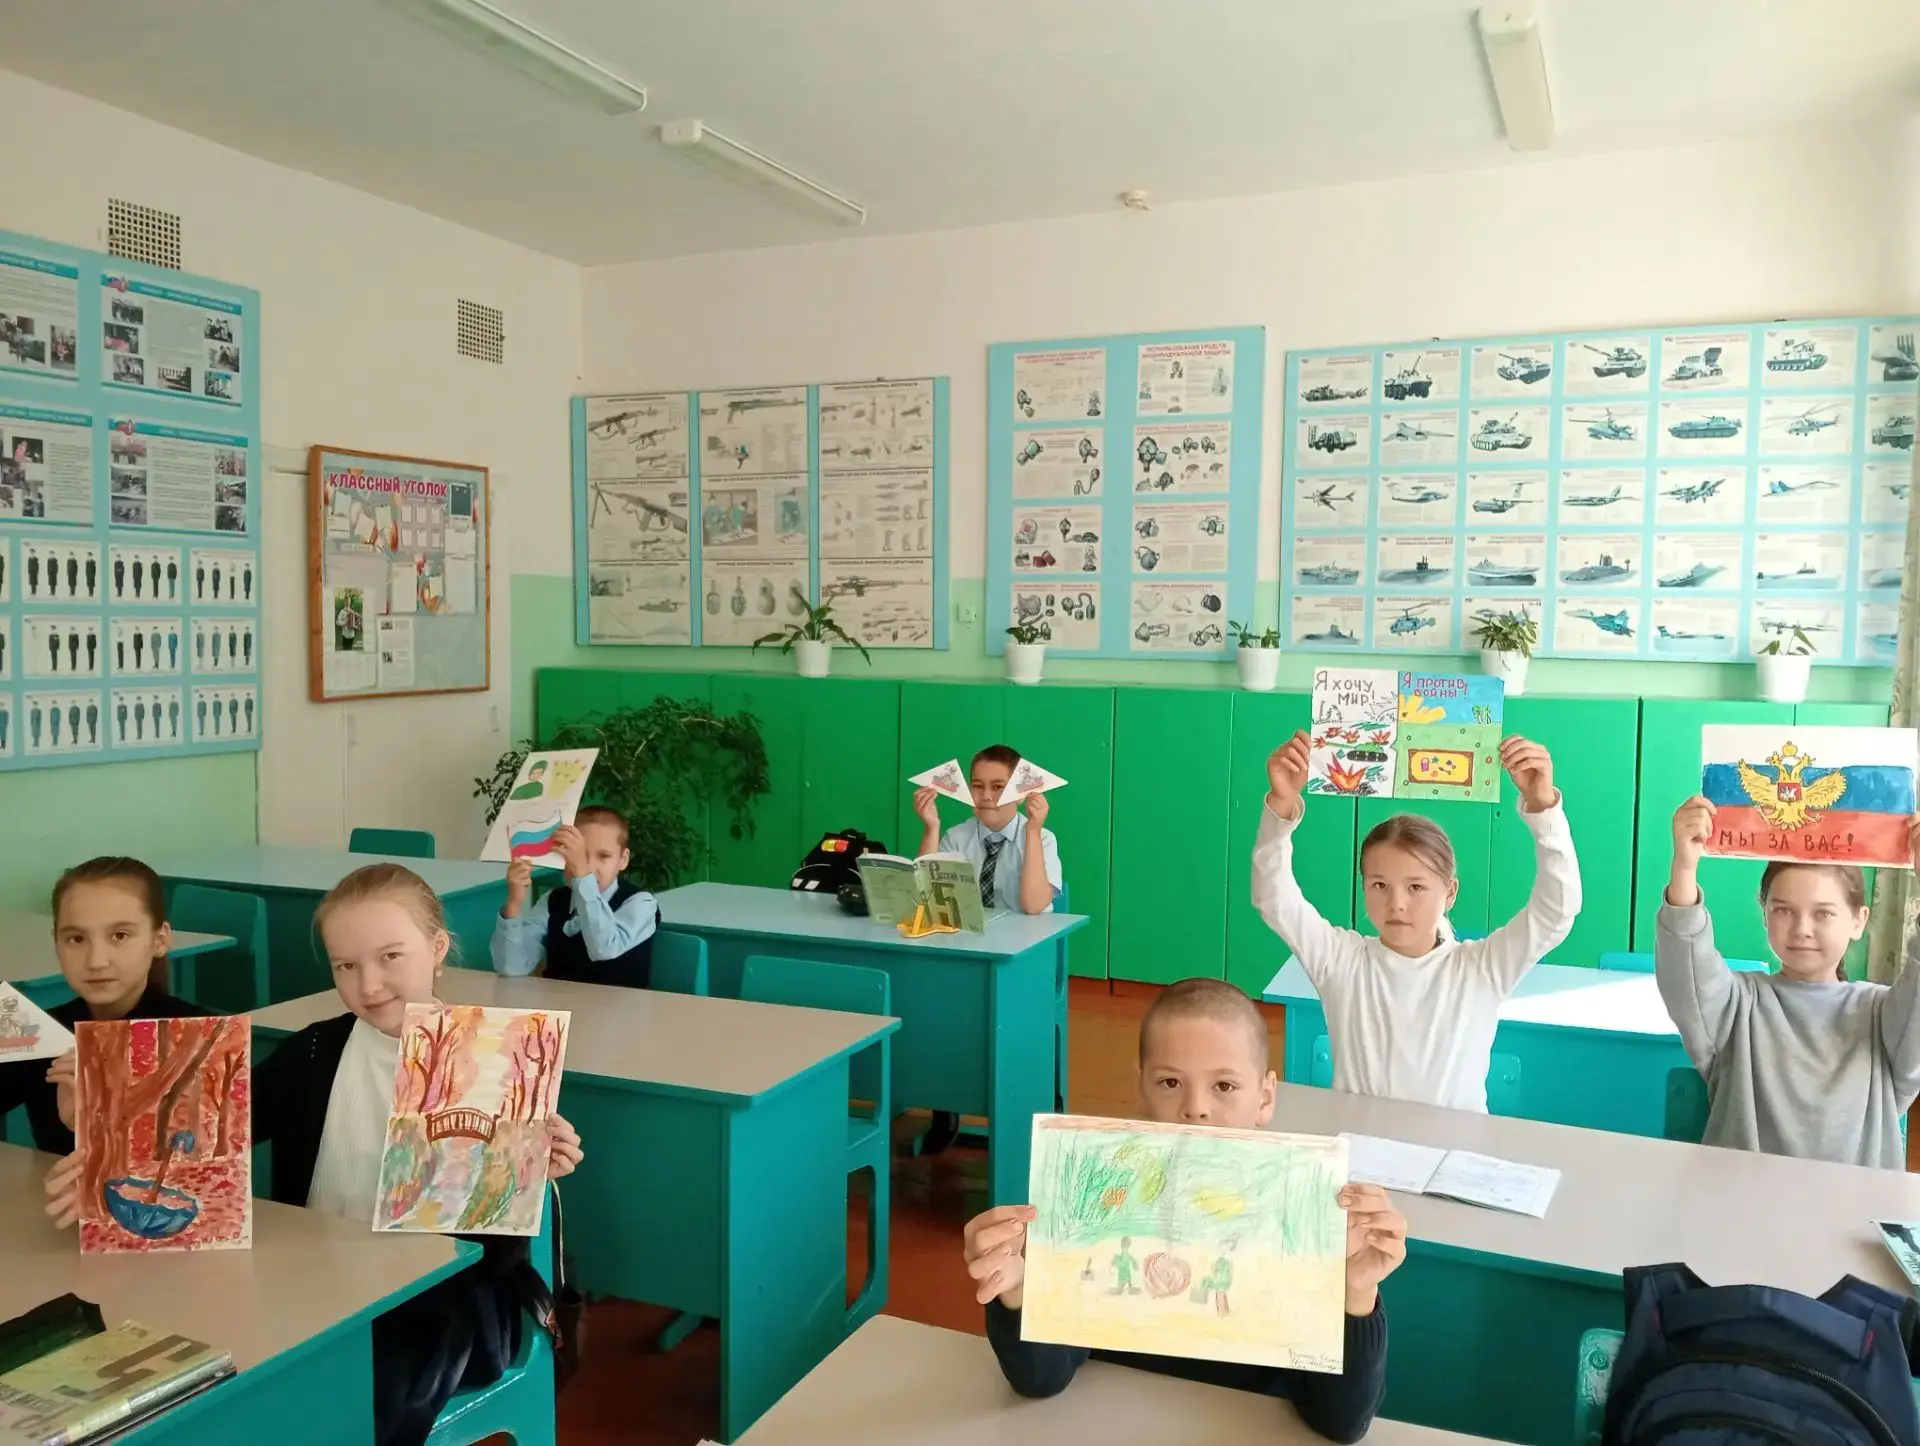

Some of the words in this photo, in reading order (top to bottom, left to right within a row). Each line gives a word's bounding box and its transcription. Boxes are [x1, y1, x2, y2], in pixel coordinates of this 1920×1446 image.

[329, 473, 400, 493] КЛАССНЫЙ
[1315, 671, 1327, 691] Я
[1402, 671, 1411, 688] Я
[1338, 690, 1376, 706] МИР!
[1719, 829, 1756, 847] МЫ
[1768, 833, 1789, 850] ЗА
[1804, 833, 1854, 852] ВАС!
